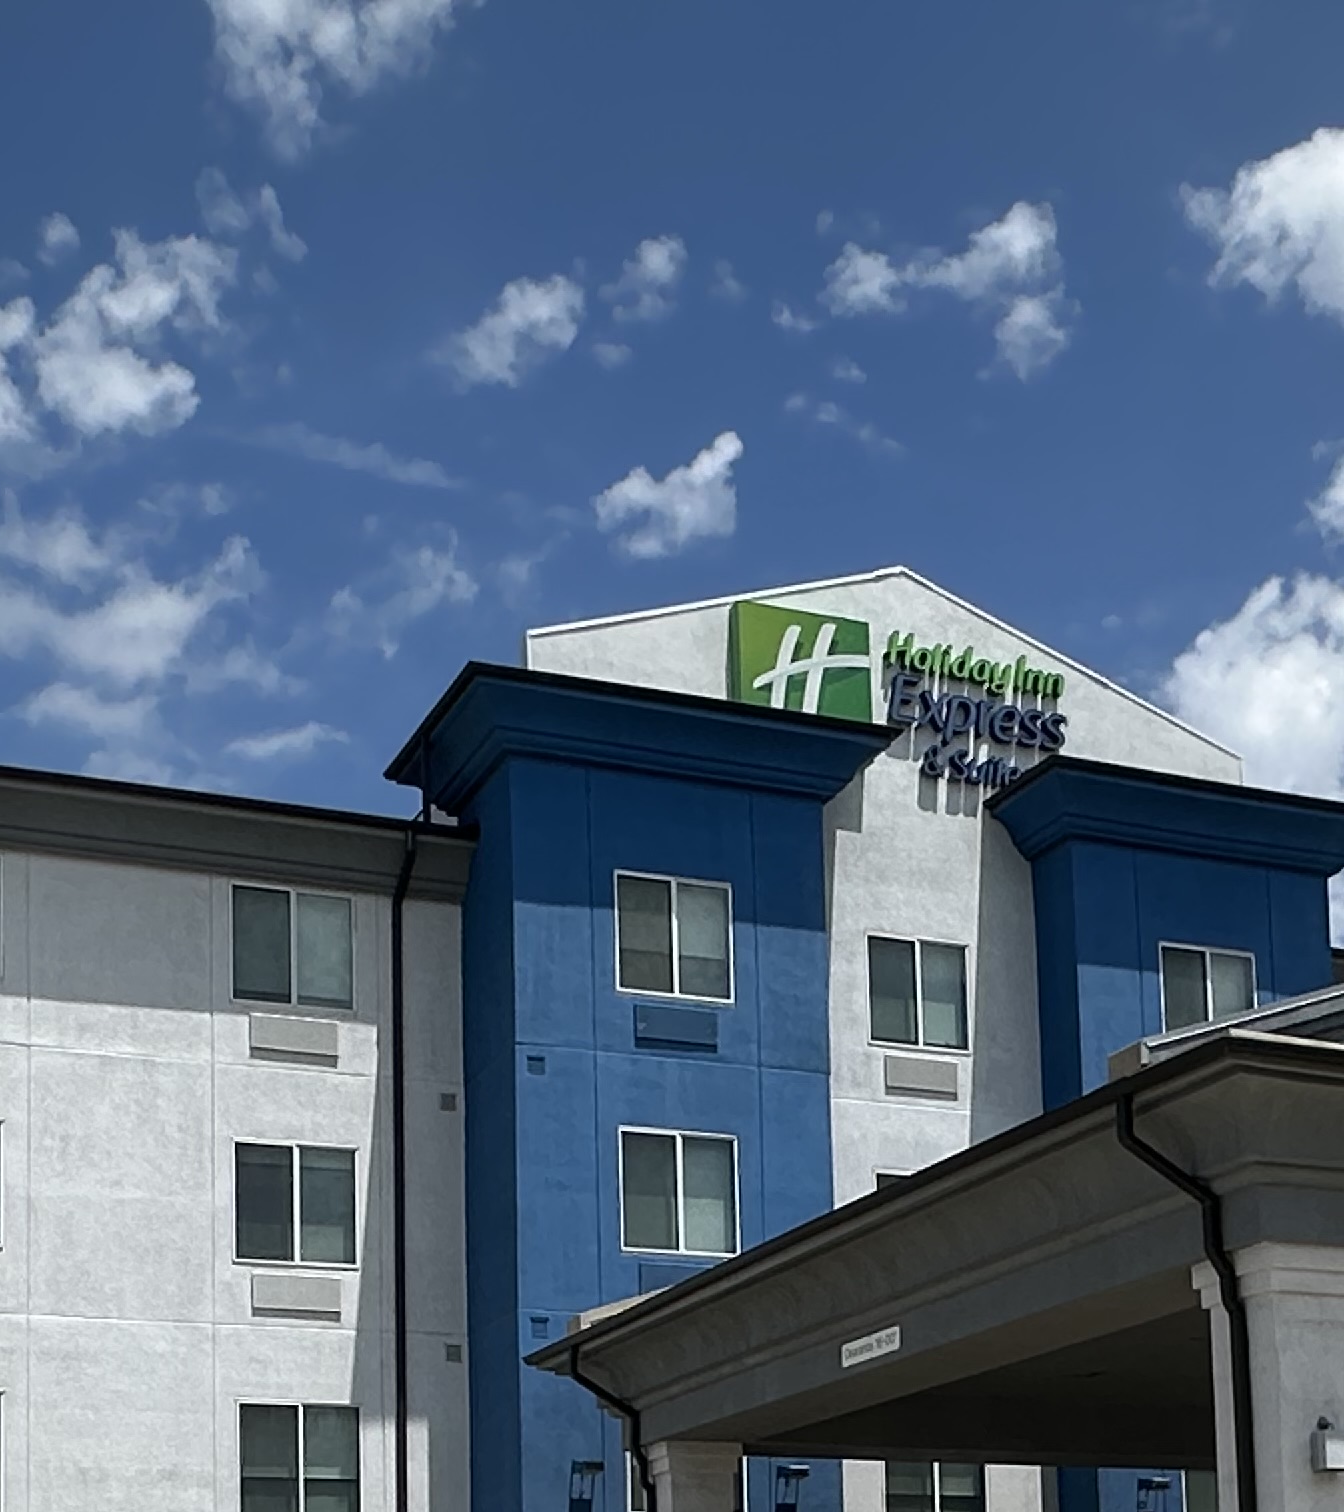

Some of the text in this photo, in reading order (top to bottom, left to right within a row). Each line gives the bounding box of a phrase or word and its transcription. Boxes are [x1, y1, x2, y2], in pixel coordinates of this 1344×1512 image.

[885, 630, 1065, 698] Holiday Inn
[889, 672, 1068, 751] Express
[922, 744, 944, 776] &
